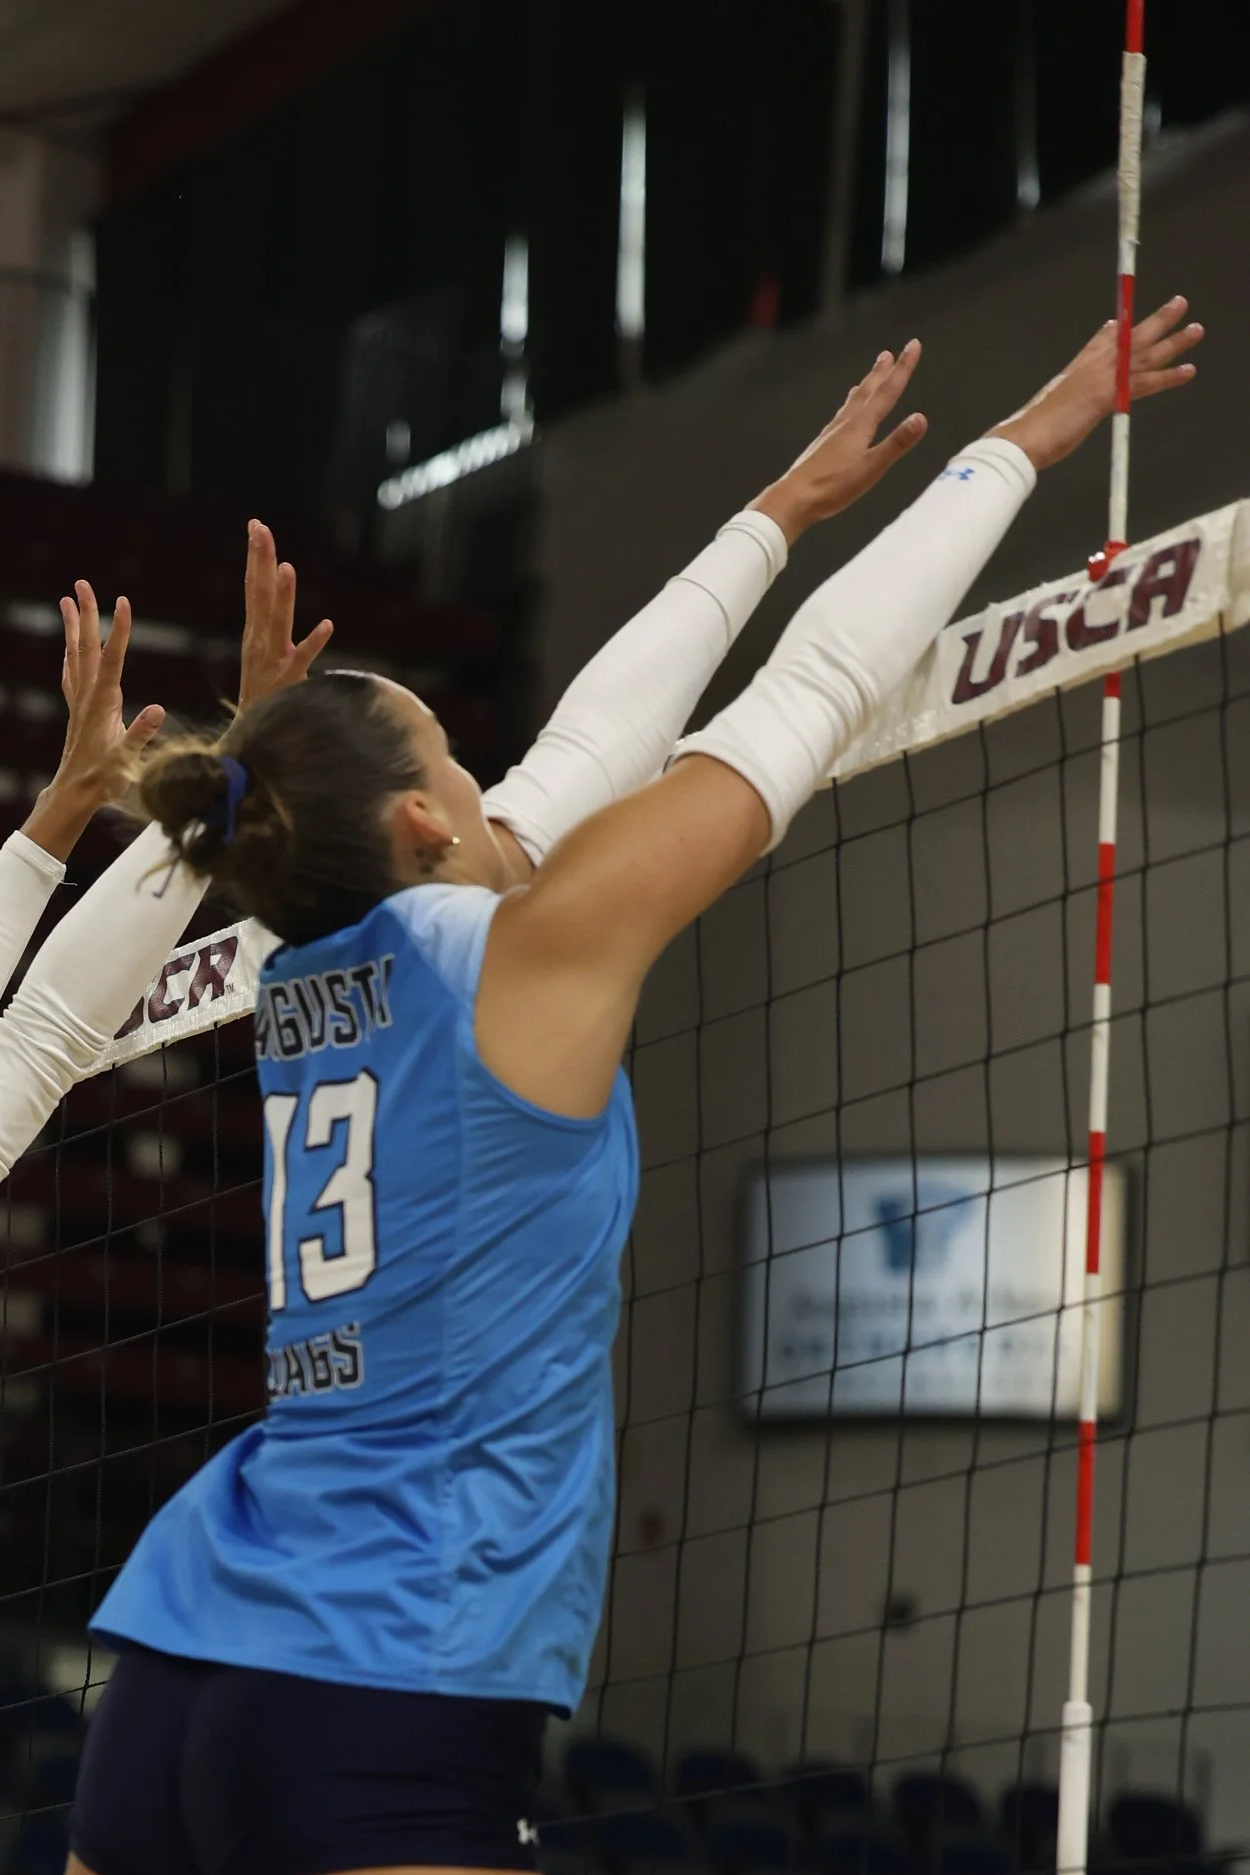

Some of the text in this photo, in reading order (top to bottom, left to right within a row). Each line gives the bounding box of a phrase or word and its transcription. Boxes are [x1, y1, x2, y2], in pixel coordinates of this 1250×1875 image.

[951, 537, 1201, 705] USCA
[113, 935, 238, 1041] CA
[264, 1067, 379, 1312] 13
